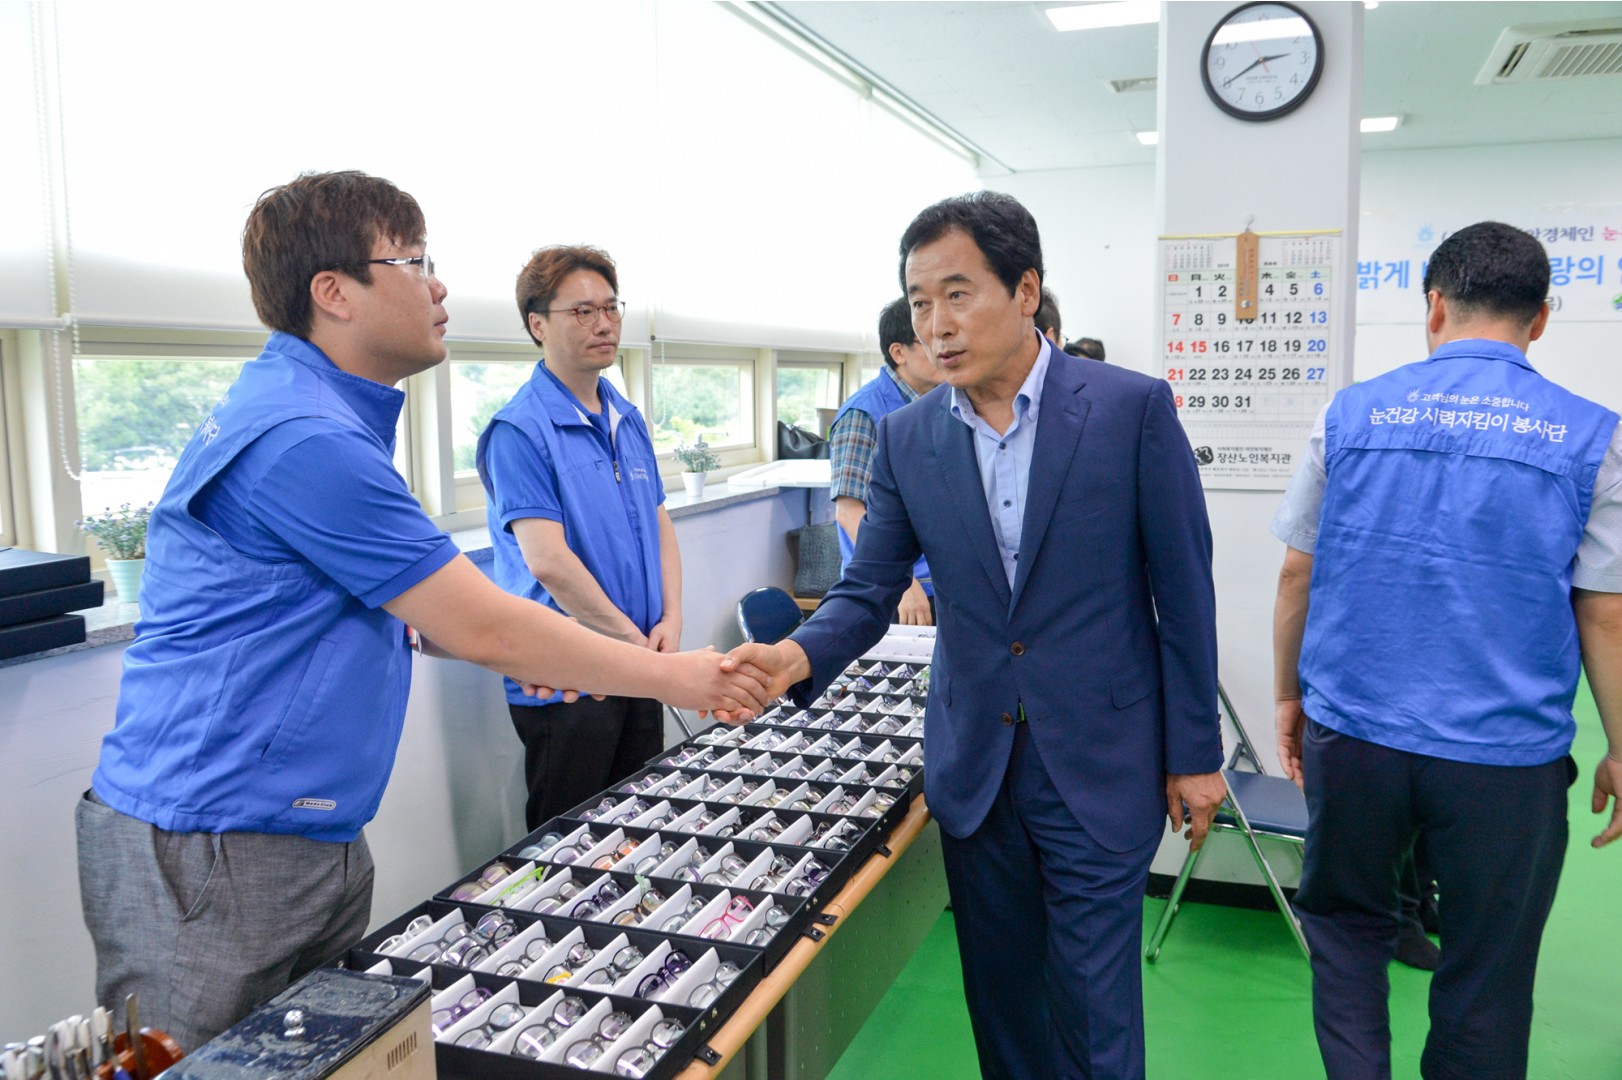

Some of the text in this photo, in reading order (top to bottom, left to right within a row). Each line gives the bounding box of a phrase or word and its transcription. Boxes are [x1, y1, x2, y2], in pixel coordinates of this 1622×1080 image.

[1216, 57, 1225, 69] 9
[1299, 51, 1308, 64] 3
[1289, 73, 1298, 85] 4
[1238, 87, 1246, 101] 7
[1255, 91, 1264, 105] 6
[1274, 86, 1282, 100] 5
[1602, 226, 1622, 242] 눈
[1168, 274, 1179, 282] 日
[1213, 272, 1226, 281] 火
[1285, 271, 1298, 280] 金
[1310, 270, 1321, 279] 土
[1357, 260, 1410, 290] 밝게
[1550, 255, 1605, 287] 랑의
[1195, 283, 1324, 298] 1 2 4 5 6
[1172, 313, 1182, 326] 7
[1194, 313, 1204, 326] 8
[1217, 313, 1227, 326] 9
[1261, 312, 1277, 324] 11
[1285, 312, 1303, 324] 12
[1309, 311, 1328, 324] 13
[1168, 340, 1327, 353] 14 15 16 17 18 19 20
[1167, 368, 1326, 381] 21 22 23 24 25 26 27
[1175, 396, 1184, 408] 8
[1188, 396, 1206, 408] 29
[1211, 396, 1230, 408] 30
[1234, 396, 1251, 408] 31
[1421, 392, 1530, 412] 고객님의 눈은 소중합니다
[1369, 407, 1568, 442] 눈건강 시력지킴이 봉사단
[1217, 453, 1292, 464] 장산노인복지관
